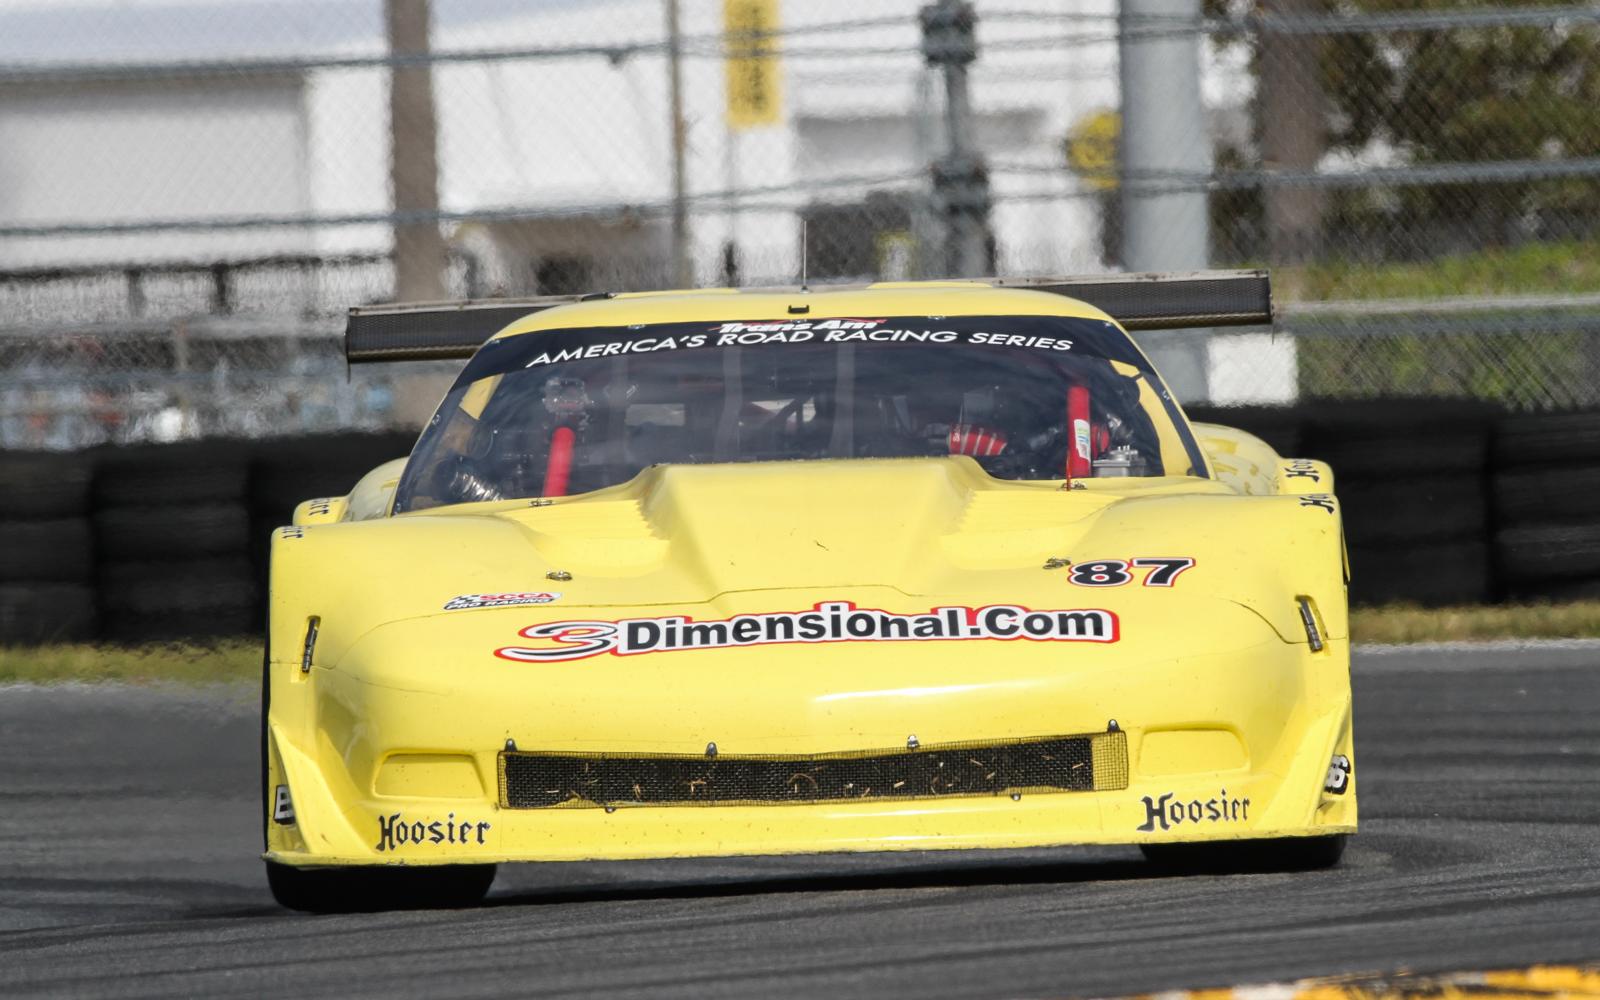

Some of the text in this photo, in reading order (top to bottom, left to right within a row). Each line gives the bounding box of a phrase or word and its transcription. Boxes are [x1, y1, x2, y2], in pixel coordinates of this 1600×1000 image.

[718, 320, 878, 334] Trans Am
[526, 329, 1074, 367] AMERICA'S ROAD RACING SERIES
[1067, 557, 1196, 587] 87
[445, 598, 548, 609] PRO RACING
[1136, 788, 1250, 832] Hoosier
[376, 812, 491, 851] Hoosier
